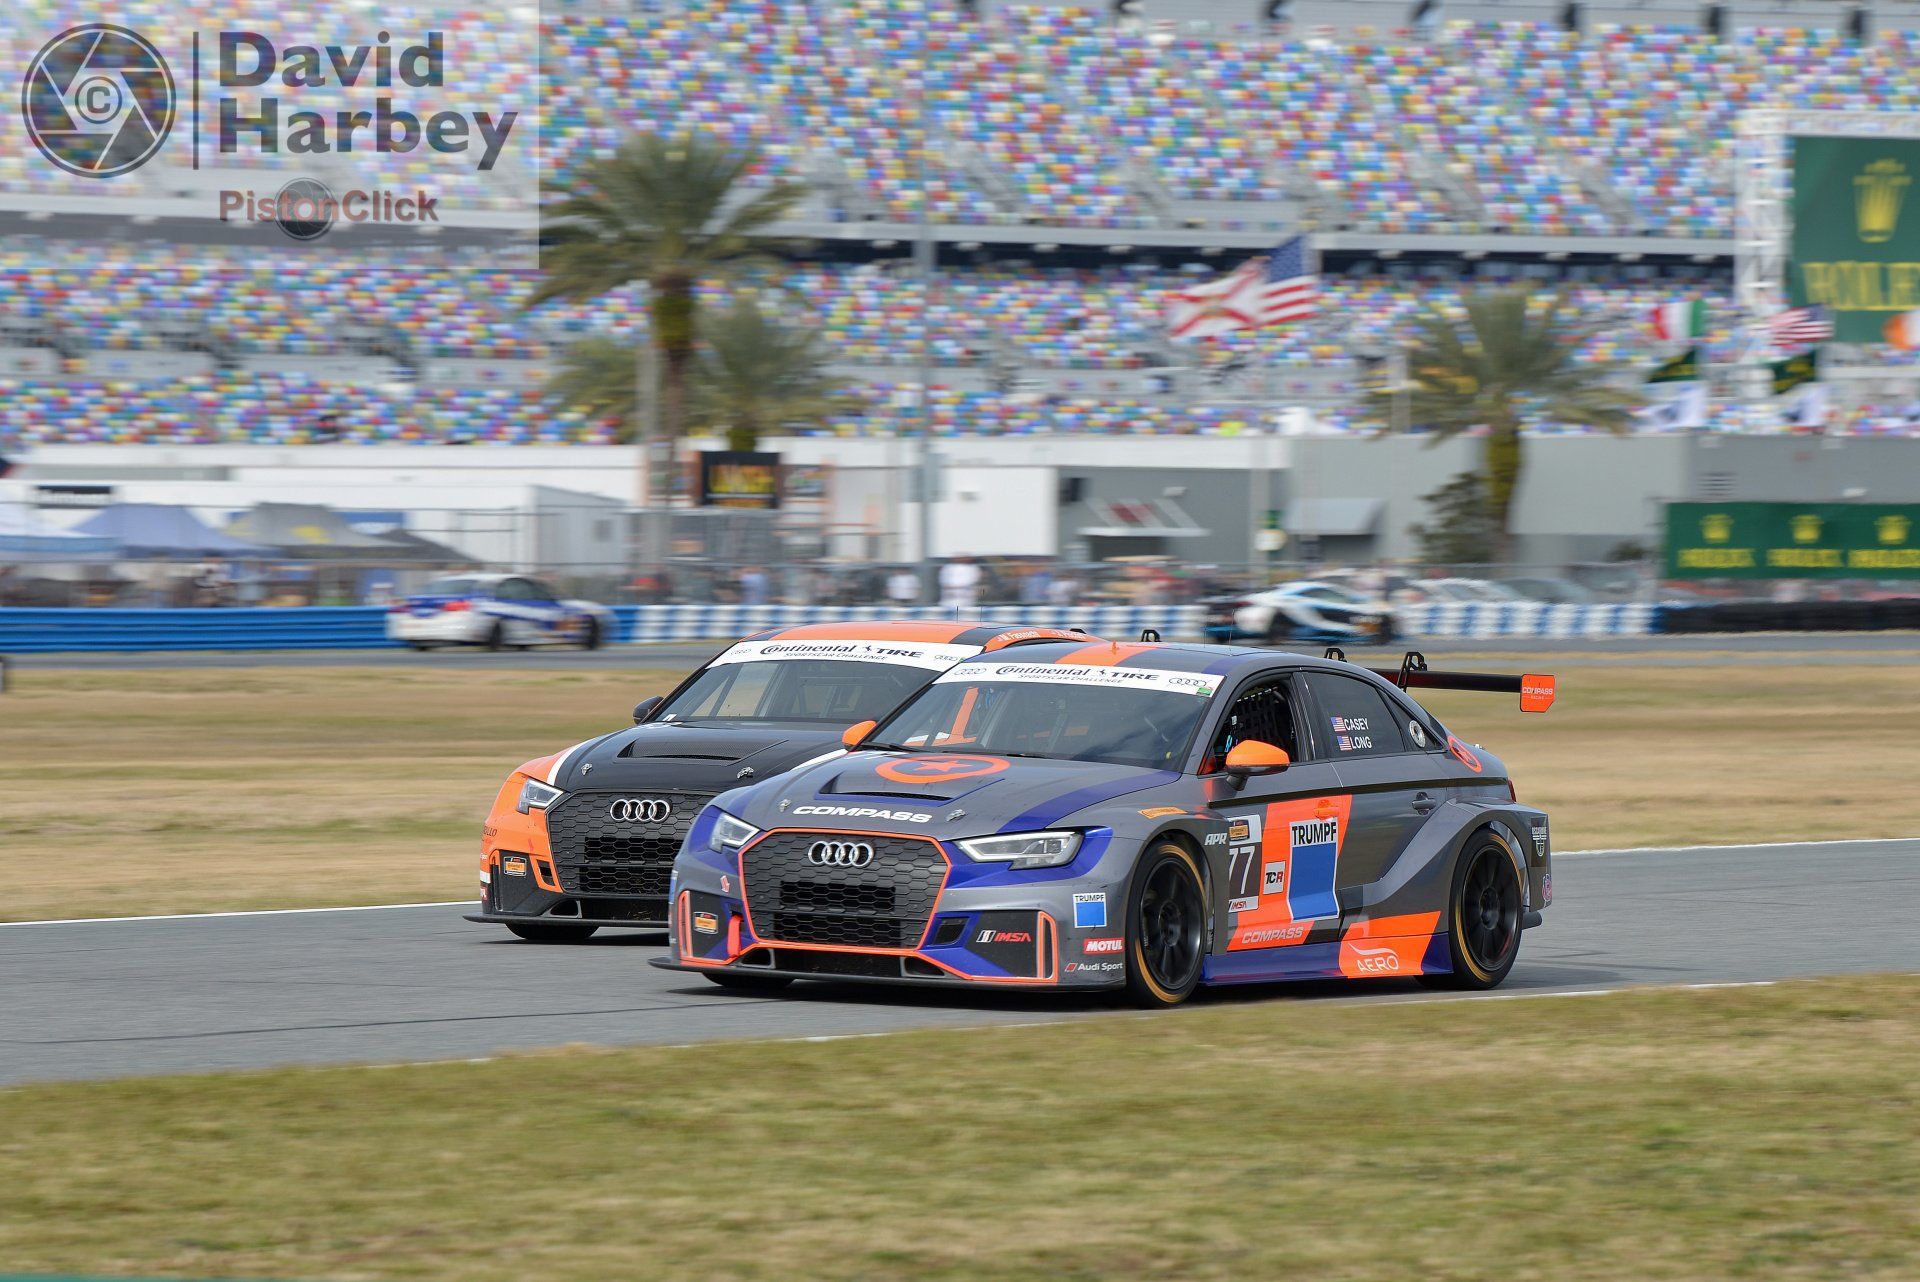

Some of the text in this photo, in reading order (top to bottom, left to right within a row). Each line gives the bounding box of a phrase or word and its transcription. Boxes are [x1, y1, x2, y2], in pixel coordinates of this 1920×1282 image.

[759, 644, 925, 659] Continental TIRE
[995, 665, 1161, 681] Continental TIRE
[1522, 686, 1554, 695] COMPASS
[1343, 717, 1369, 731] CASEY
[1349, 735, 1372, 750] LONG
[792, 805, 933, 824] COMPASS
[1204, 832, 1228, 846] APR
[1291, 821, 1337, 846] TRUMPF
[1229, 845, 1256, 895] 77
[1265, 870, 1283, 885] TCR
[1074, 892, 1106, 903] TRUMPF
[994, 932, 1032, 943] IMSA
[1241, 926, 1304, 944] COMPASS
[1085, 939, 1124, 953] MOTUL
[1077, 961, 1124, 973] Audi Sport
[1357, 955, 1400, 974] AERO
